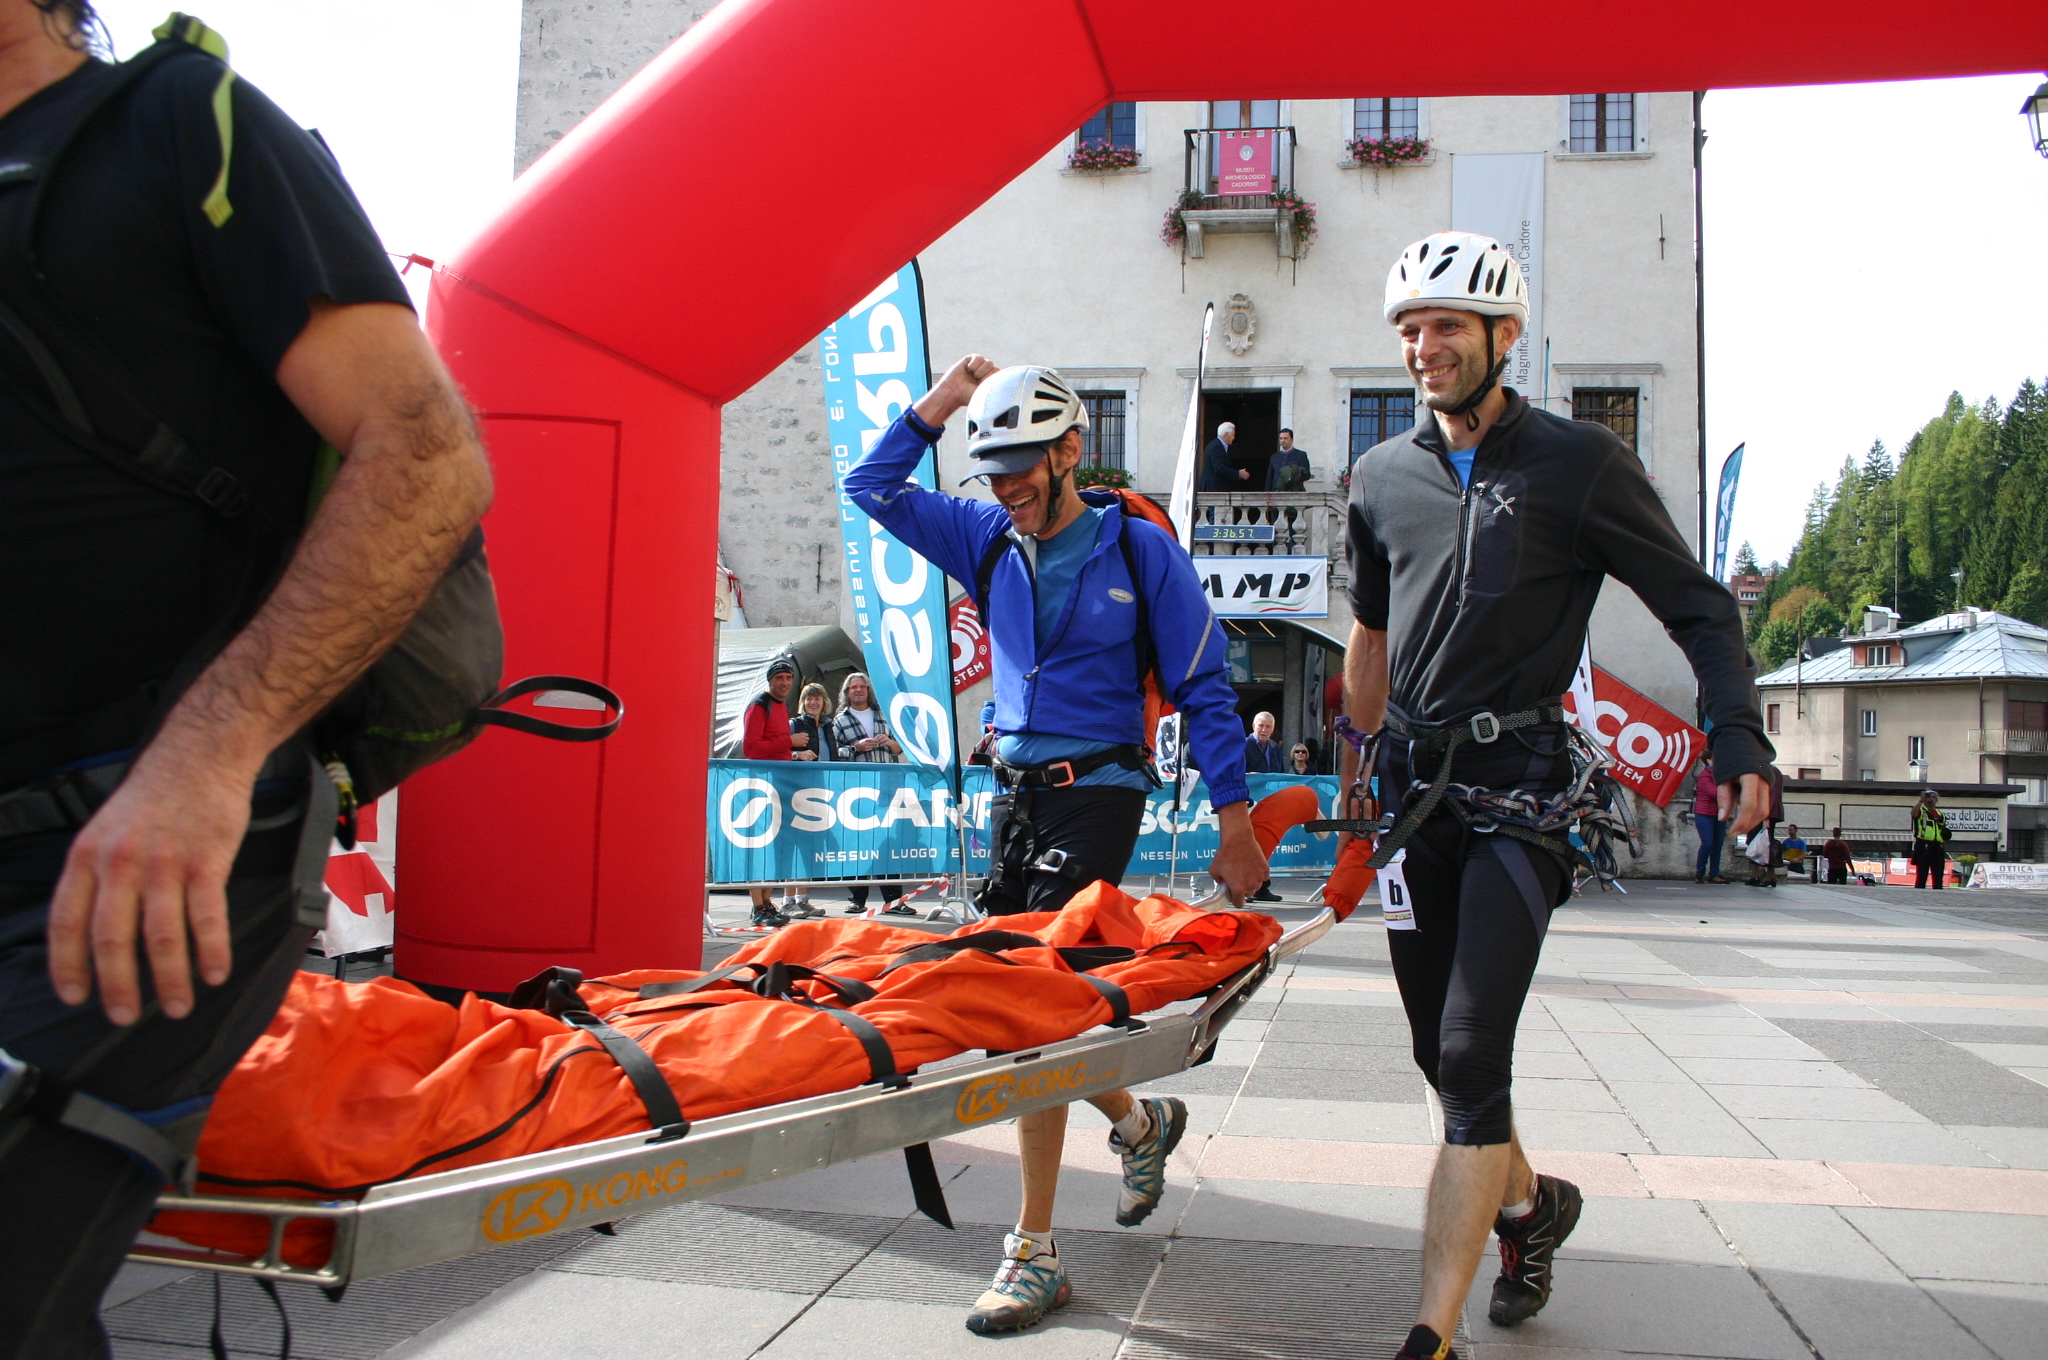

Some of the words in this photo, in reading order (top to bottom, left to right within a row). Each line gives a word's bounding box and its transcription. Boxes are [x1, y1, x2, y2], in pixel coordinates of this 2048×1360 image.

[1224, 173, 1266, 181] ARCHEOLOGICO
[1518, 220, 1531, 260] Cadore
[1612, 757, 1644, 784] TEM
[1959, 810, 1971, 821] del
[1973, 810, 1996, 821] Dolce
[1945, 821, 1989, 830] Pasticceria
[815, 849, 880, 863] NESSUN
[891, 848, 938, 859] LUOGO
[1999, 865, 2033, 873] OTTICA
[1015, 1061, 1087, 1101] KONG
[579, 1160, 689, 1213] KONG
